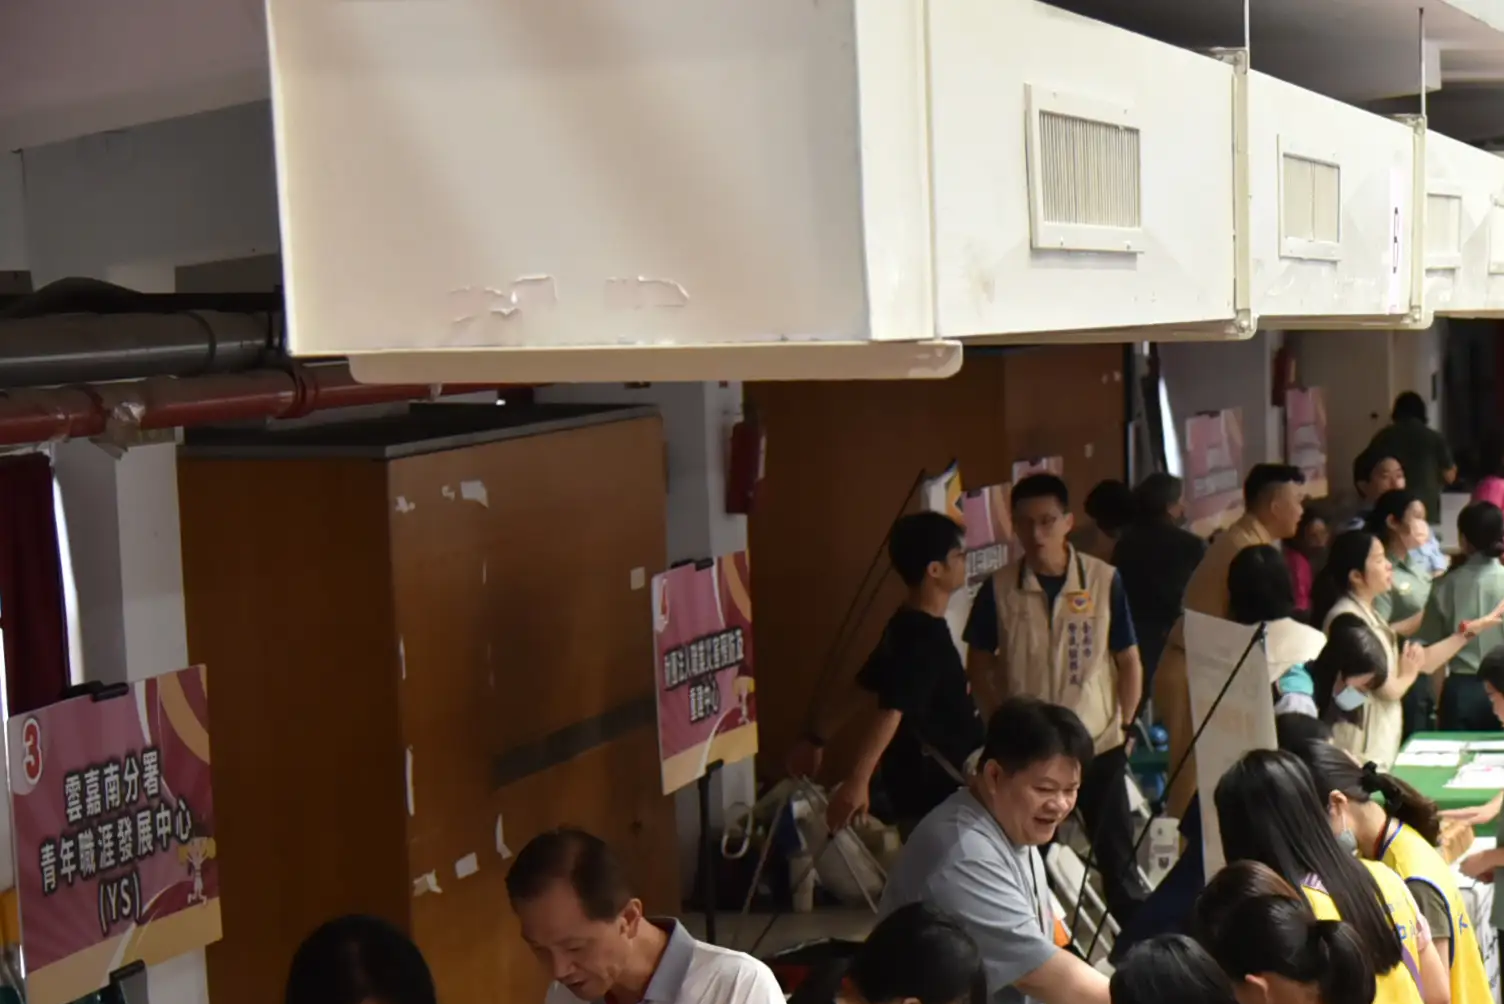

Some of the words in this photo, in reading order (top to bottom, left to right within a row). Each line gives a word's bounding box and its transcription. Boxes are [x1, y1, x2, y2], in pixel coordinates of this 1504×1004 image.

[23, 718, 42, 785] 3
[65, 751, 159, 822] 雲嘉南分署
[40, 802, 192, 893] 青年職涯發展中心
[99, 872, 141, 933] (YS)
